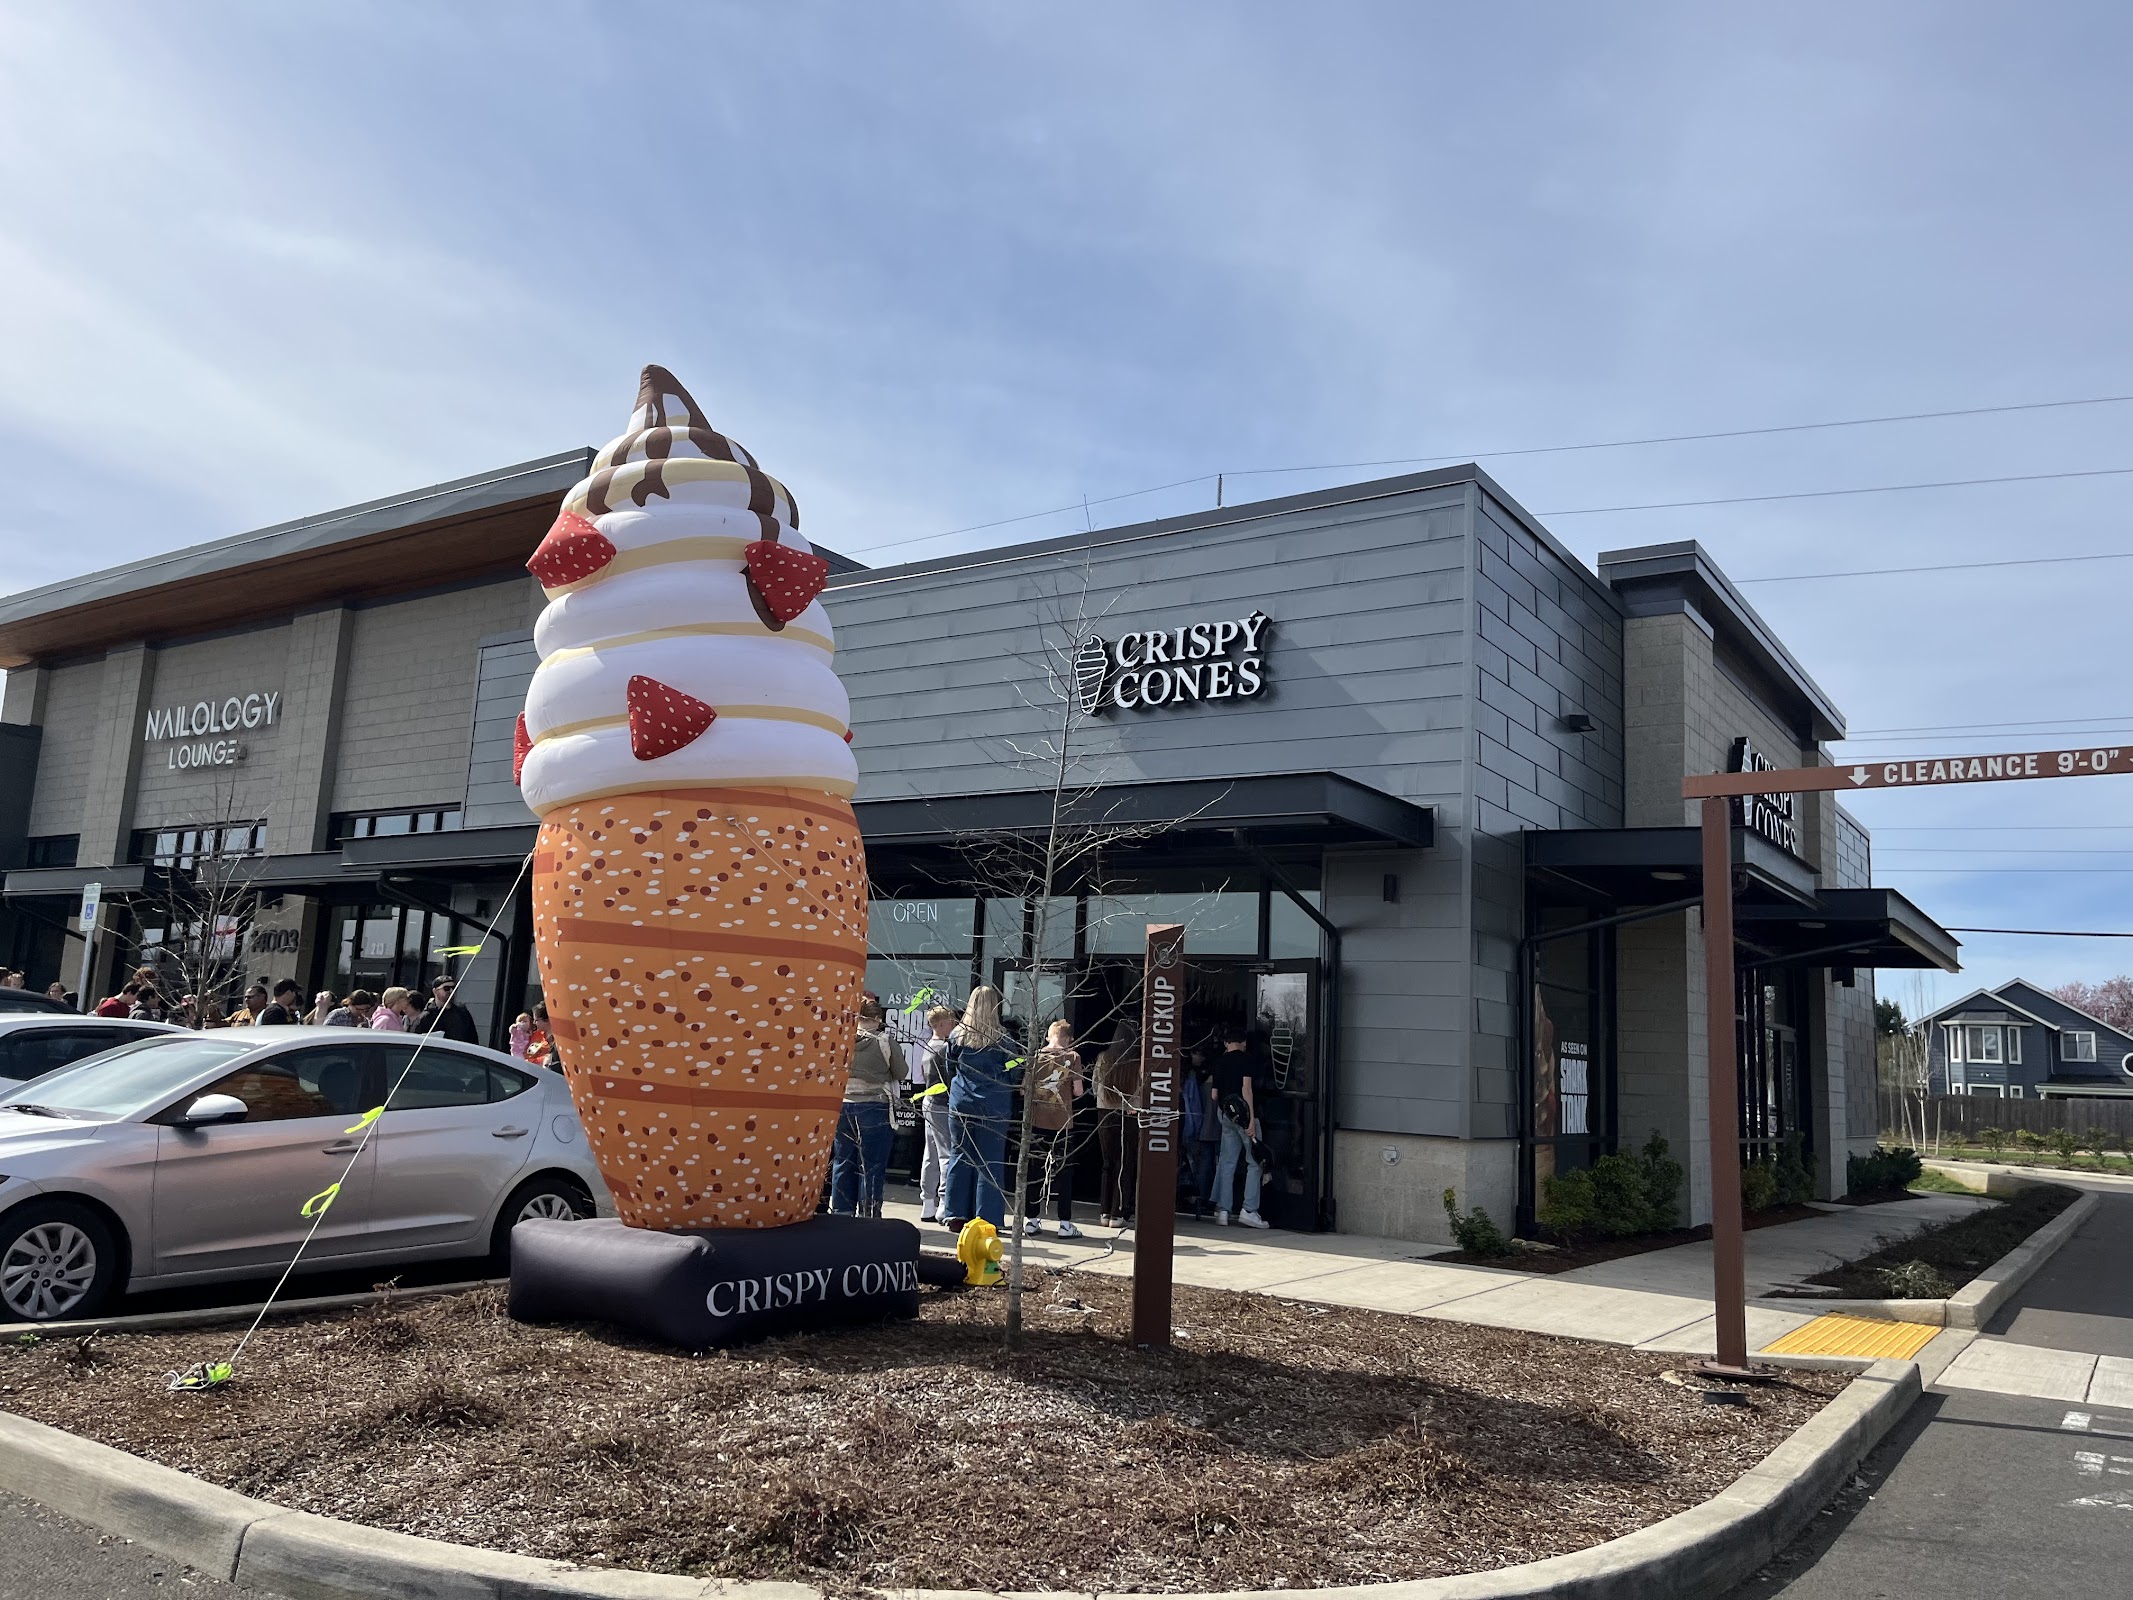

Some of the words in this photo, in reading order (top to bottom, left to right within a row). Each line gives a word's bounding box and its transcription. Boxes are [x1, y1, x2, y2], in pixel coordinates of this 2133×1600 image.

[1115, 611, 1267, 668] CRISPY
[1113, 658, 1261, 709] CONES
[145, 691, 279, 741] NAILOLOGY
[168, 740, 238, 770] LOUNGE
[1884, 754, 2039, 784] CLEARANCE
[893, 903, 938, 922] OPEN
[887, 993, 902, 1005] AS
[1152, 975, 1176, 1060] PICKUP
[1560, 1041, 1568, 1054] AS
[1568, 1042, 1580, 1055] SEEN
[1580, 1044, 1588, 1056] ON
[1148, 1067, 1173, 1152] DIGITAL
[1560, 1094, 1590, 1134] TANK
[706, 1268, 834, 1317] CRISPY
[842, 1260, 919, 1297] CONES
